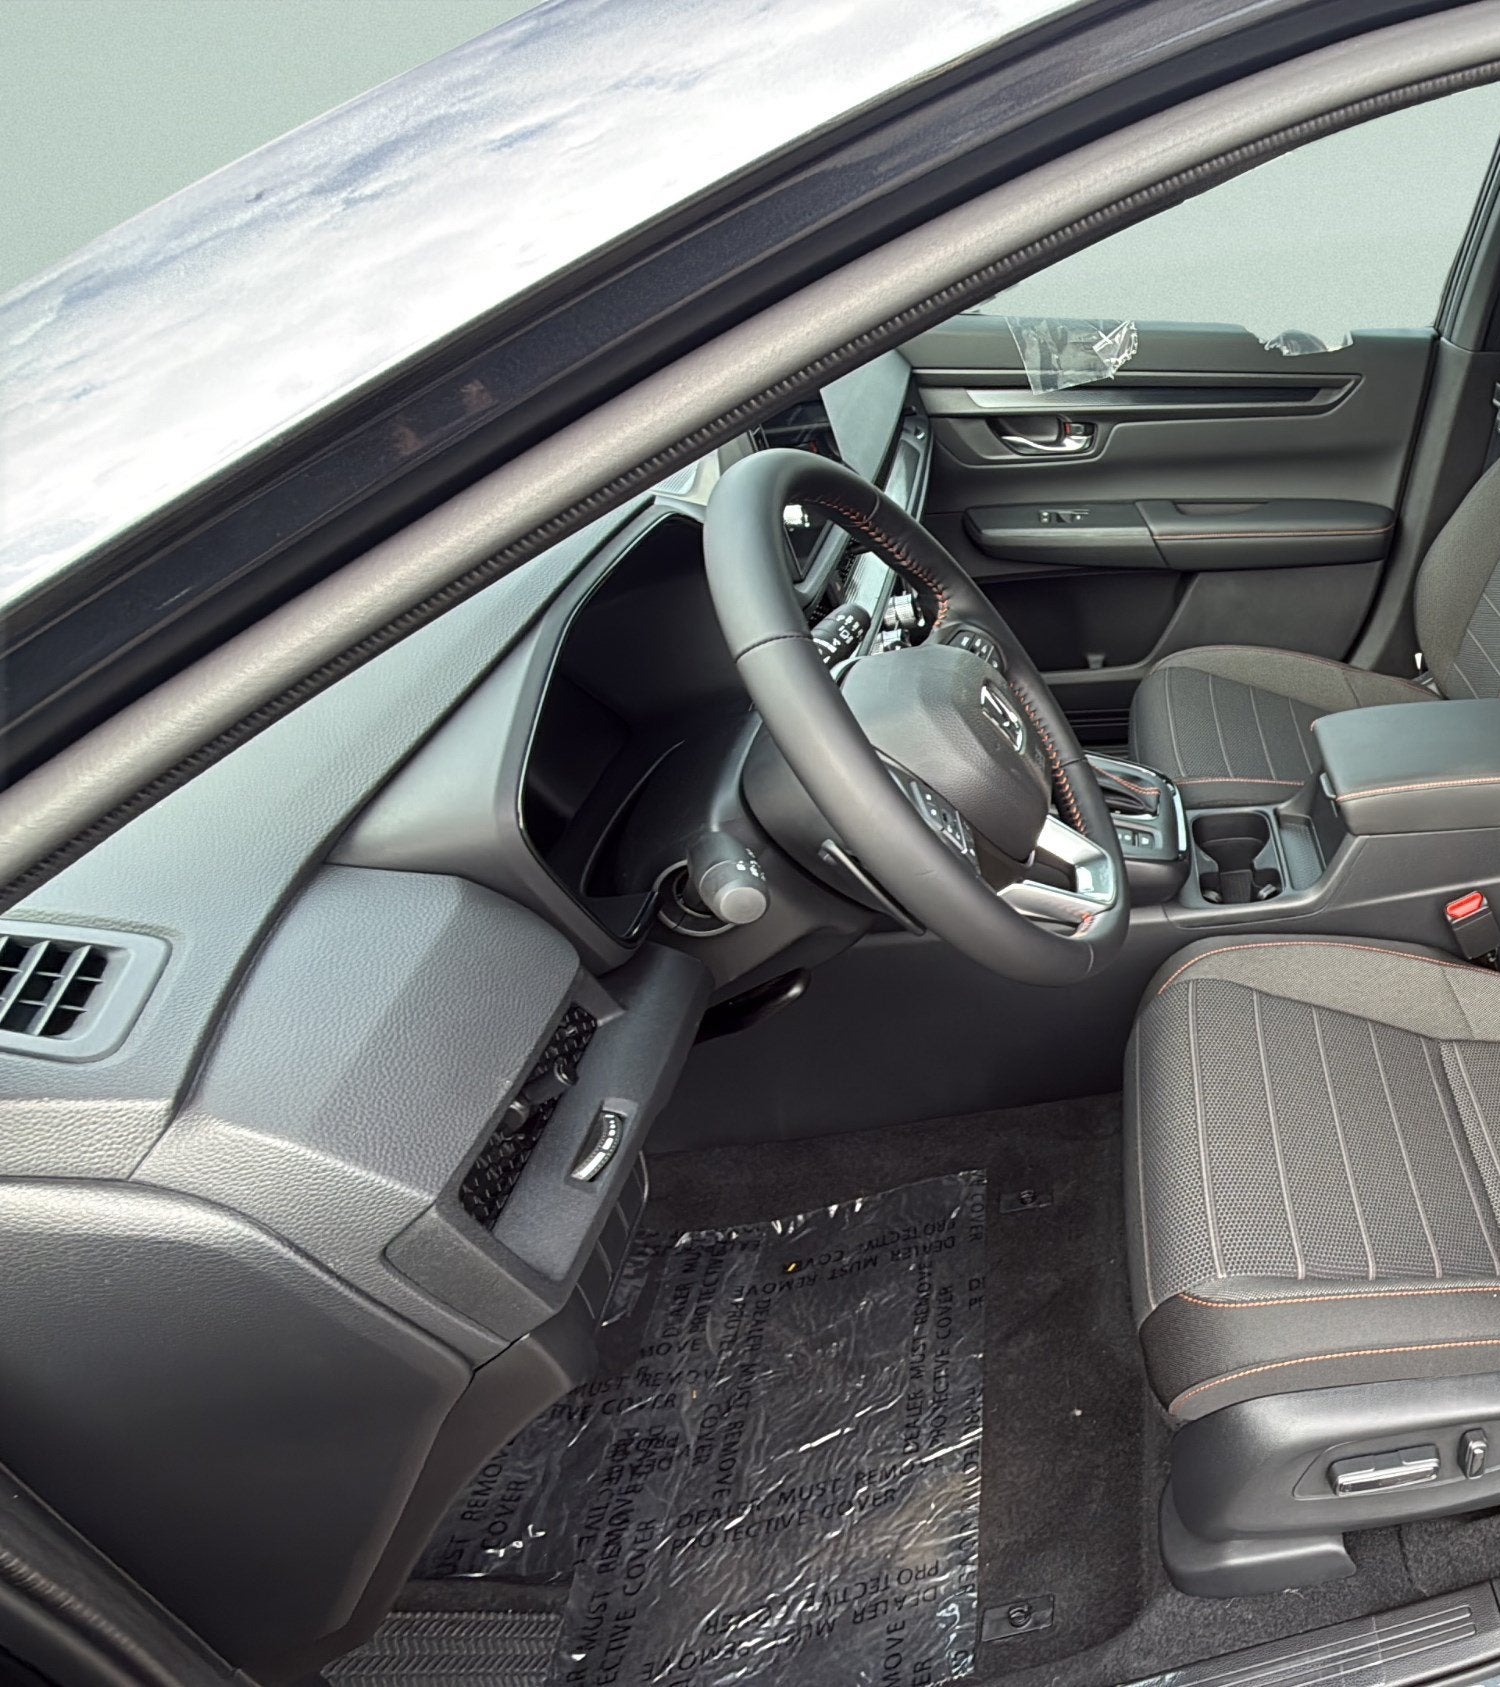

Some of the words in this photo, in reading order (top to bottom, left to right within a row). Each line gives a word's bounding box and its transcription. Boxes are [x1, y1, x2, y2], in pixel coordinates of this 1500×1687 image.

[969, 1193, 984, 1242] COVER
[935, 1284, 953, 1340] COVER
[460, 1447, 509, 1525] REMOV
[622, 1517, 656, 1597] COVER
[576, 1589, 610, 1654] MUST
